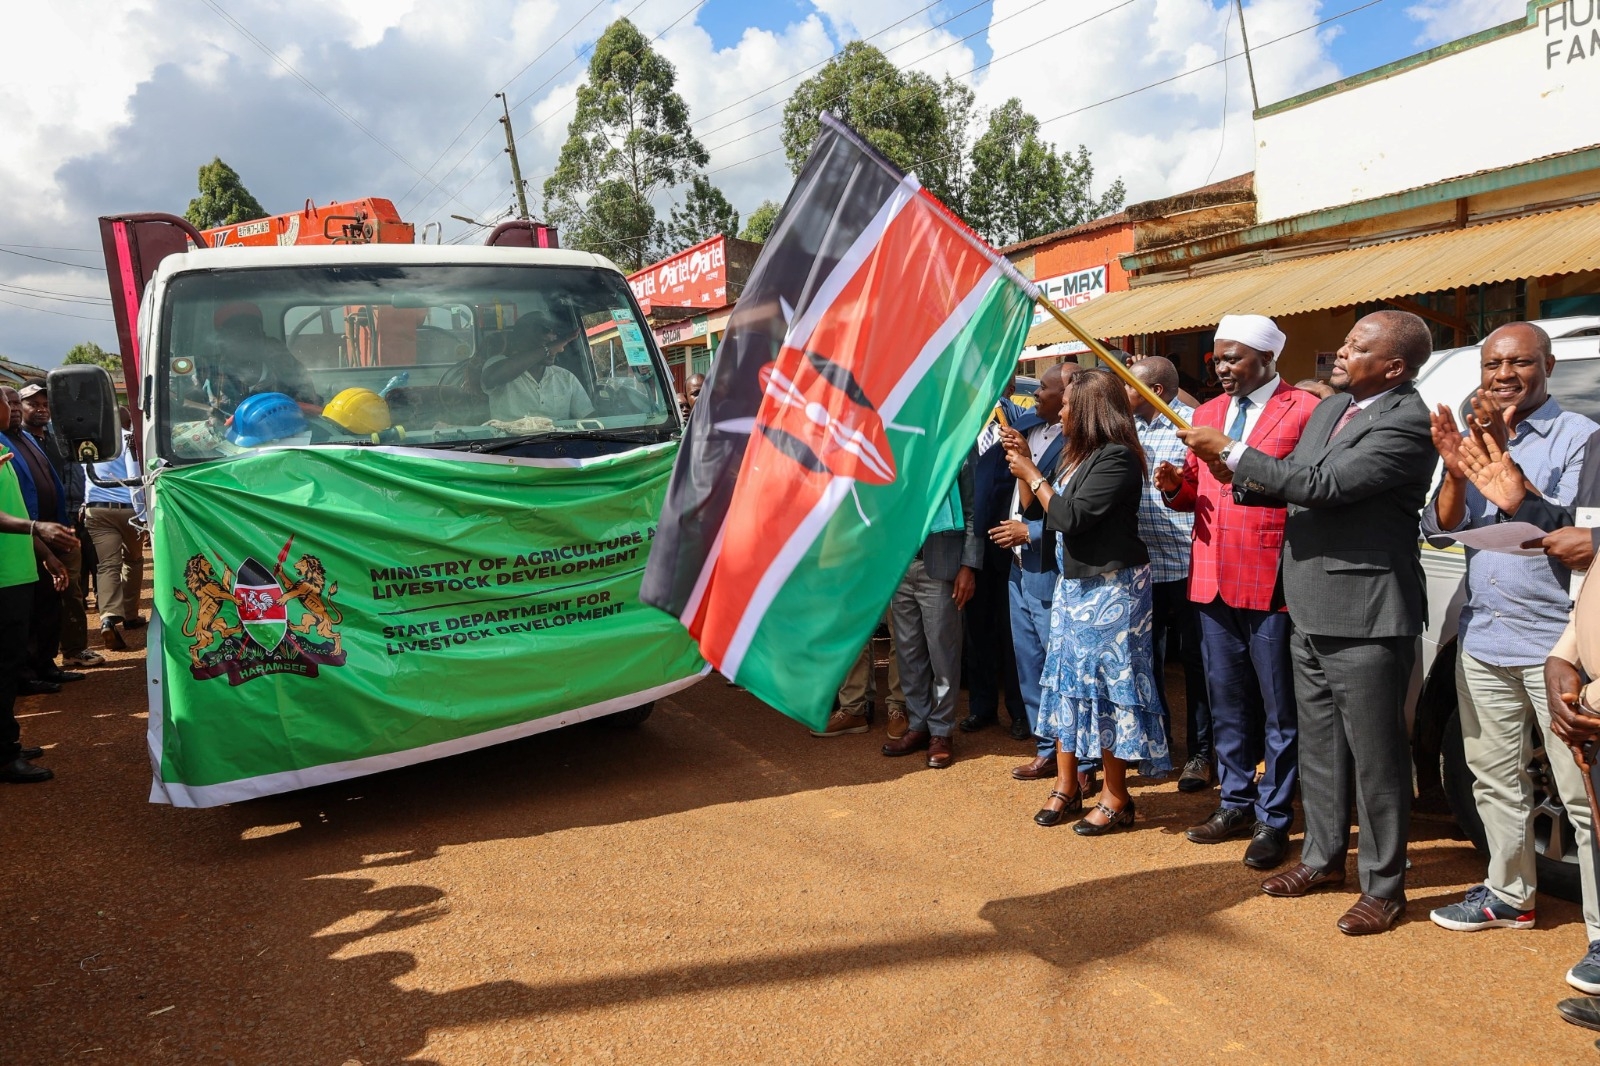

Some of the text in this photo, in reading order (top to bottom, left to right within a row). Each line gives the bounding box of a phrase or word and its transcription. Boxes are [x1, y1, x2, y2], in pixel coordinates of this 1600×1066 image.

[667, 257, 690, 286] airtel
[700, 241, 724, 273] airtel
[370, 525, 658, 582] MINISTRY OF AGRICULTURE A
[372, 547, 639, 600] LIVESTOCK DEVELOPMENT
[382, 590, 611, 639] STATE DEPARTMENT FOR
[386, 602, 624, 656] LIVESTOCK DEVELOPMENT
[239, 662, 307, 679] HARAMBEE
